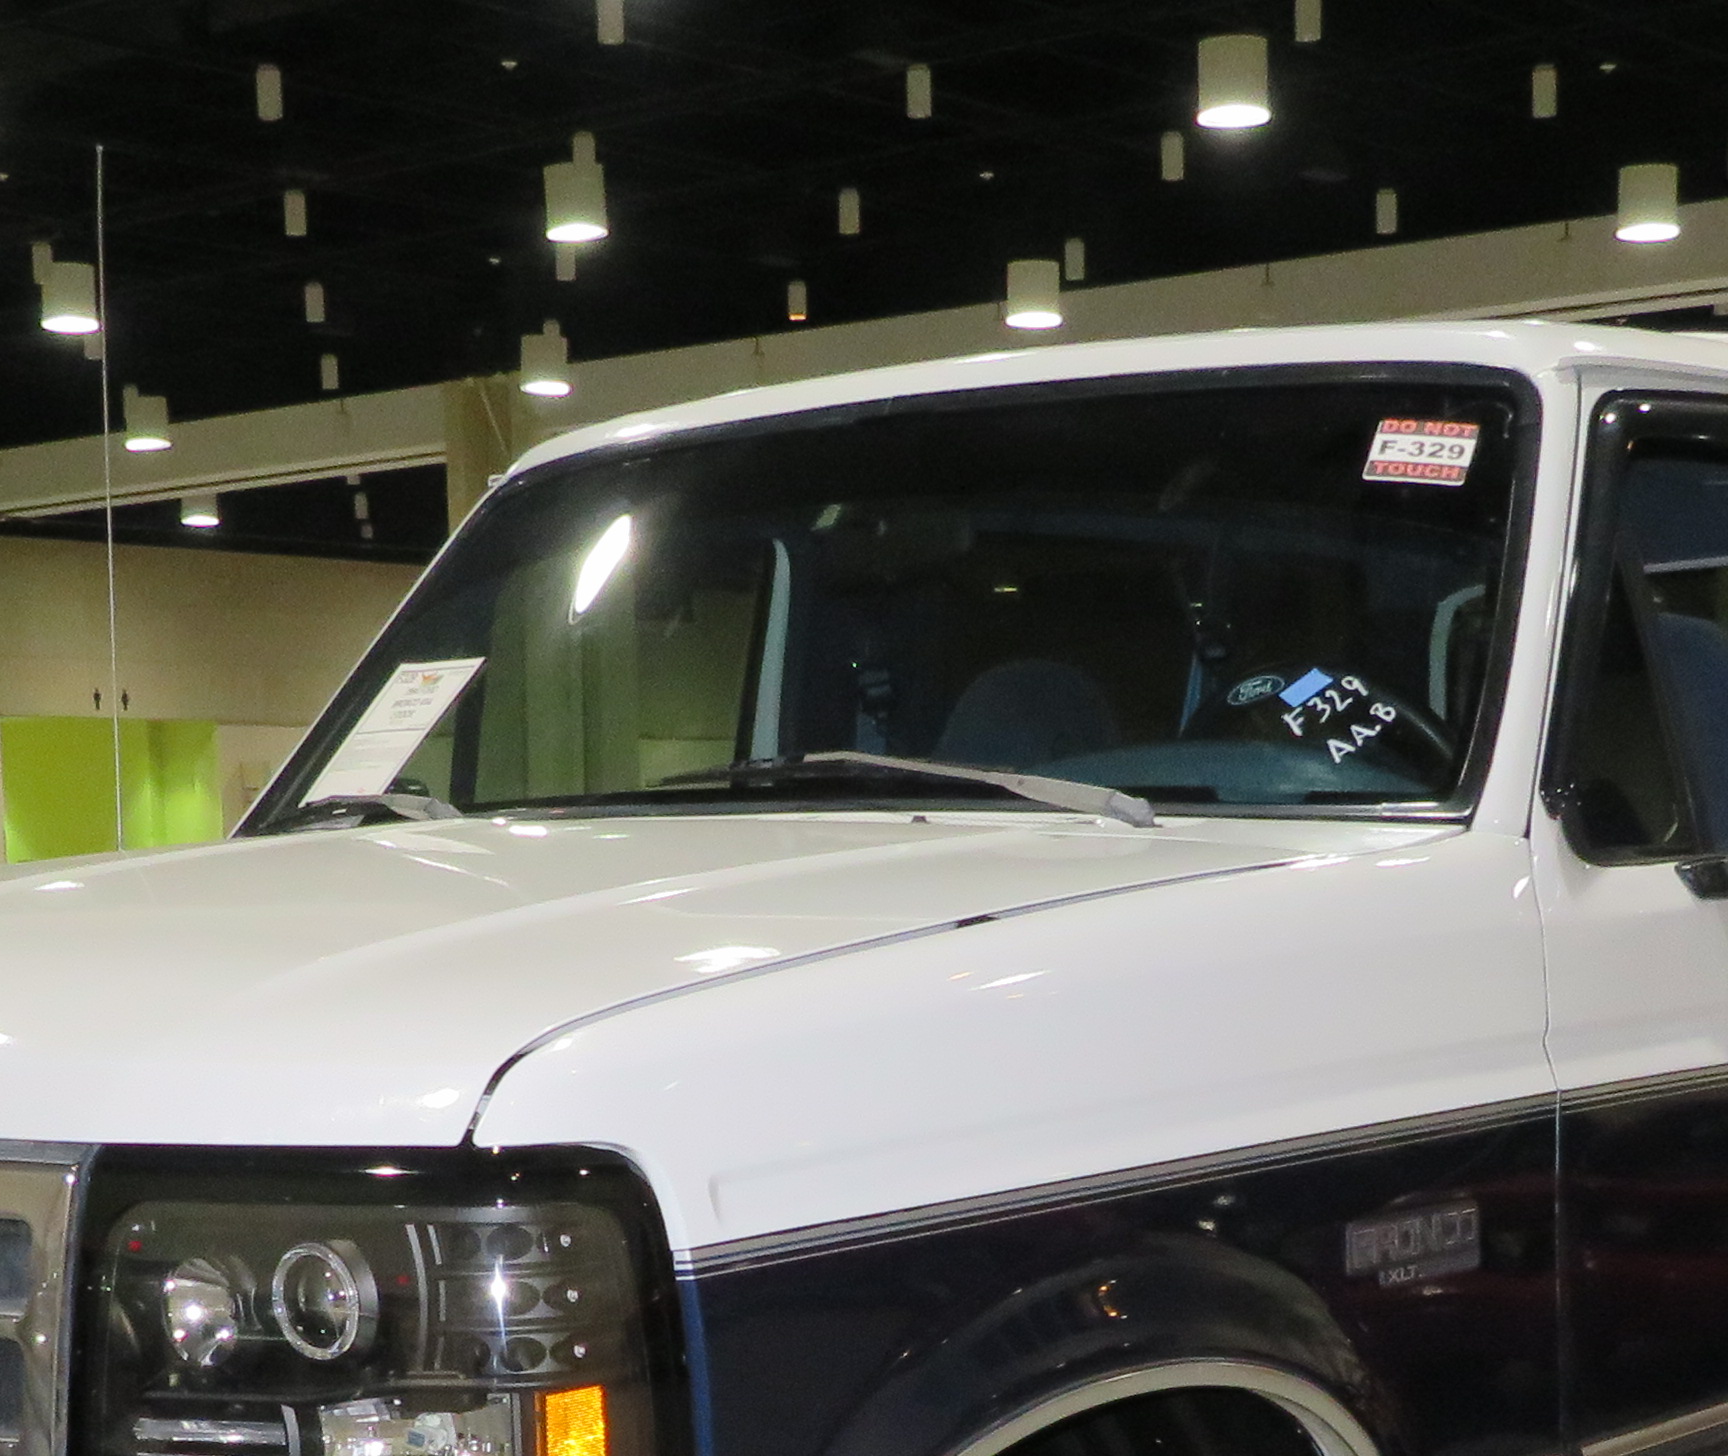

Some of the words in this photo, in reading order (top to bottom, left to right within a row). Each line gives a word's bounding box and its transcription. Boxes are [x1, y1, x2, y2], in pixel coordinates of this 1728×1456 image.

[1382, 420, 1417, 433] DO
[1424, 421, 1478, 437] NOT
[1378, 440, 1465, 460] F-329
[1374, 462, 1460, 479] TOUCH
